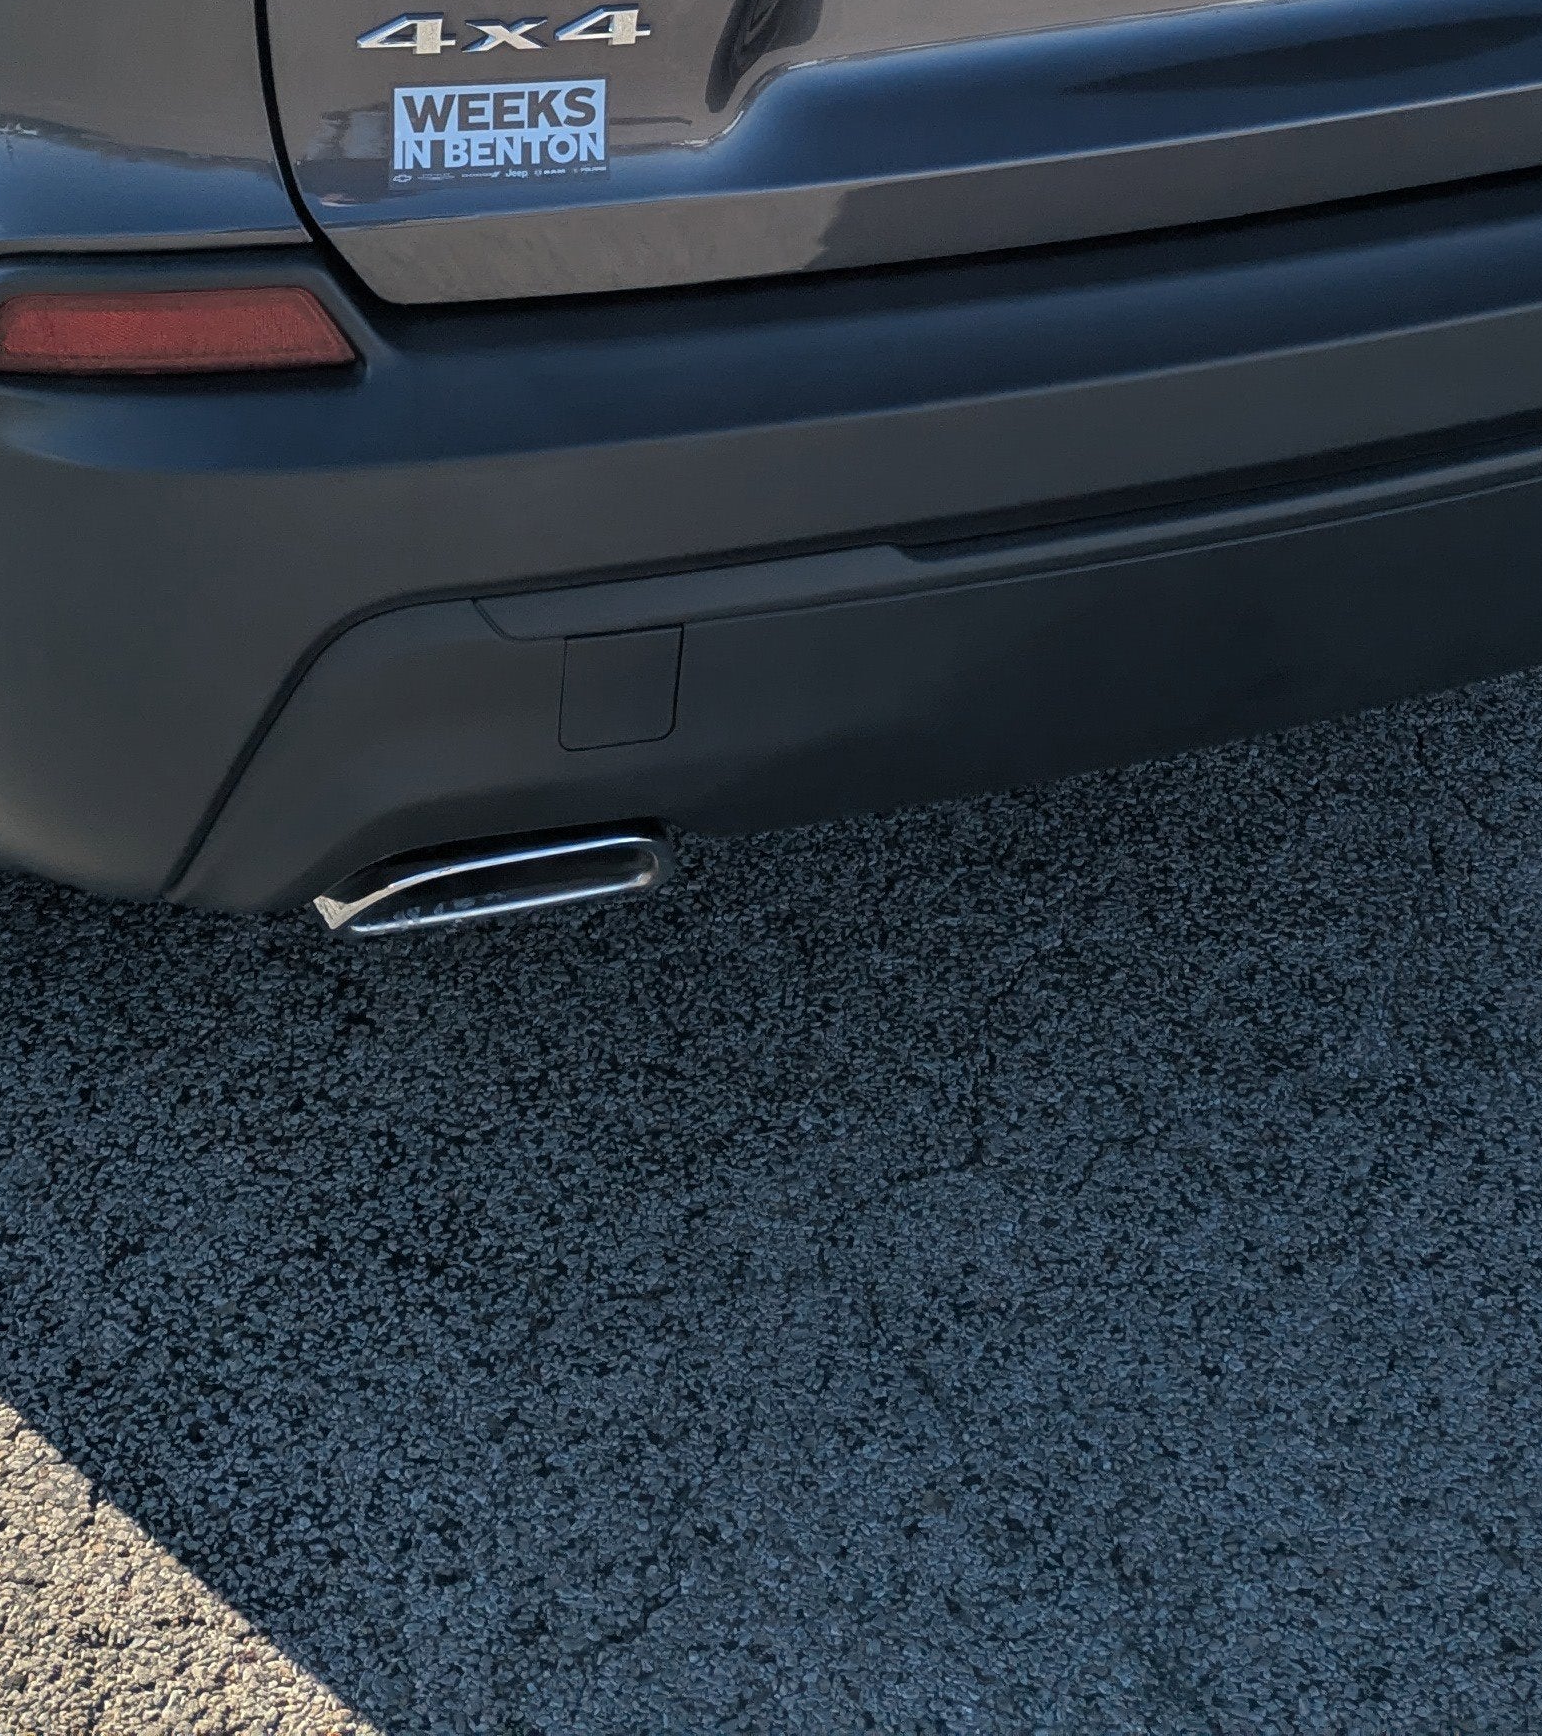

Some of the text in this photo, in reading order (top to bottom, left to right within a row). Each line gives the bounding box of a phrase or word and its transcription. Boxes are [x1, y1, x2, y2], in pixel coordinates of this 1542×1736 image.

[356, 2, 651, 55] 4x4
[402, 87, 597, 134] WEEKS
[394, 132, 606, 170] IN BENTON
[505, 169, 528, 179] Jeep
